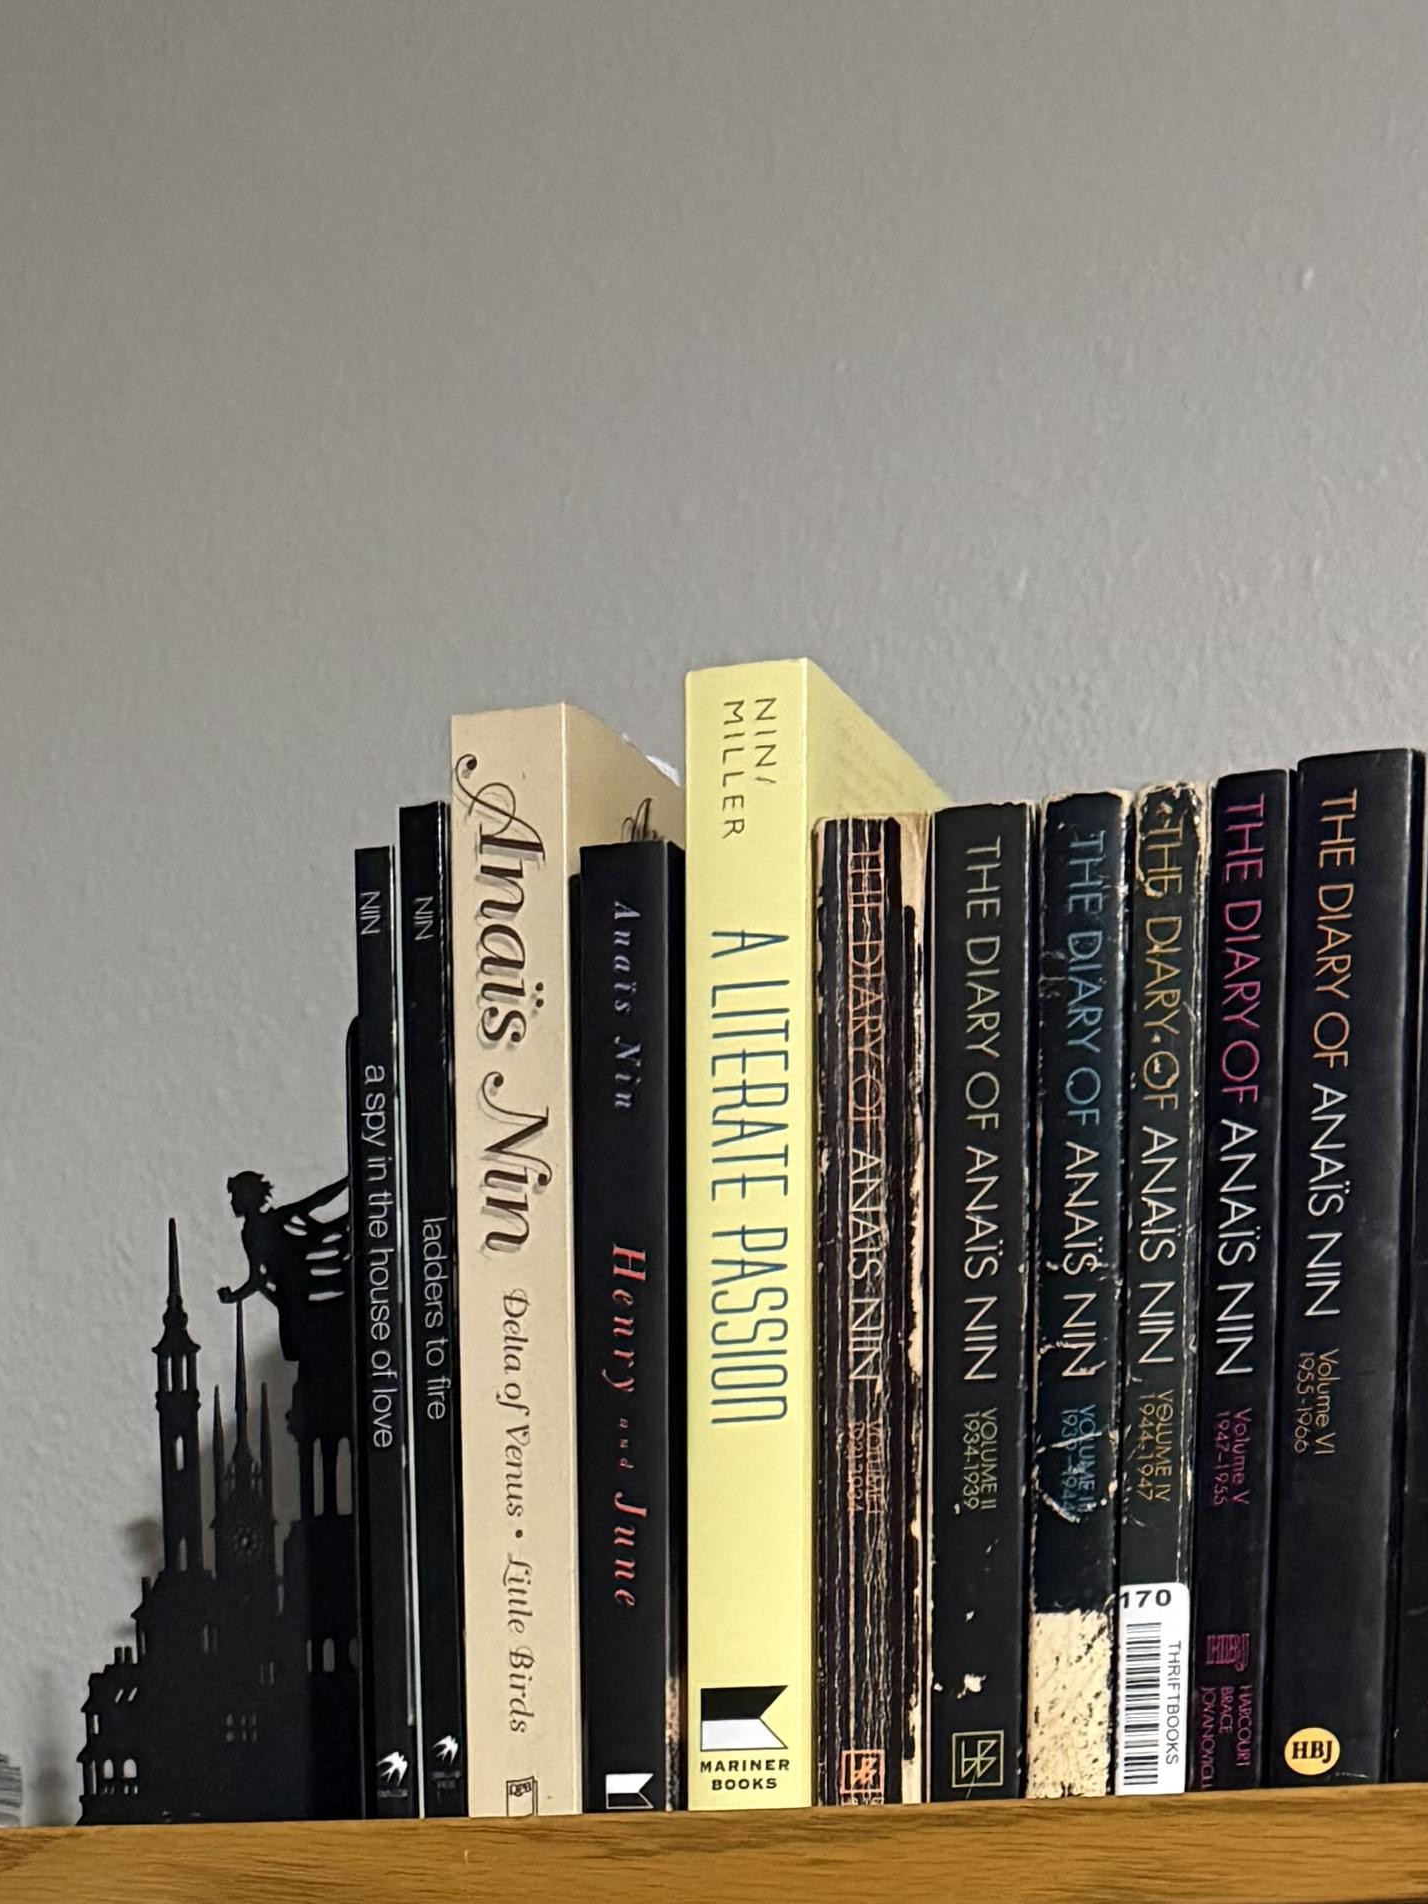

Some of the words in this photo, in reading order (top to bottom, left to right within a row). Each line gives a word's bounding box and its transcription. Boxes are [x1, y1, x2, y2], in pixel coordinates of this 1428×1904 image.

[721, 700, 745, 839] MILLER
[754, 696, 777, 785] NIN/
[1318, 788, 1359, 869] THE
[454, 752, 546, 1049] Anaïs
[1315, 883, 1355, 999] DIARY
[710, 930, 790, 960] A
[365, 1064, 386, 1085] a
[1313, 1011, 1350, 1069] OF
[361, 1090, 387, 1151] spy
[710, 979, 790, 1202] LITERATE
[366, 1157, 387, 1181] in
[479, 1070, 552, 1257] Nin
[1307, 1082, 1352, 1217] ANAÏS
[367, 1188, 391, 1239] the
[370, 1248, 395, 1338] house
[1305, 1233, 1345, 1317] NIN
[502, 1289, 530, 1377] Delta
[600, 1244, 648, 1393] Henry
[710, 1225, 789, 1425] PASSION
[373, 1345, 395, 1377] of
[496, 1381, 530, 1417] of
[373, 1379, 395, 1449] love
[618, 1418, 635, 1470] and
[504, 1418, 531, 1518] Venus
[613, 1491, 648, 1608] June
[501, 1553, 533, 1635] Little
[1119, 1589, 1173, 1610] 170
[507, 1642, 537, 1734] Birds
[1165, 1639, 1182, 1764] THRIFTBOOKS
[699, 1759, 791, 1774] MARINER
[711, 1776, 777, 1791] BOOKS
[1290, 1740, 1334, 1764] HBJ
